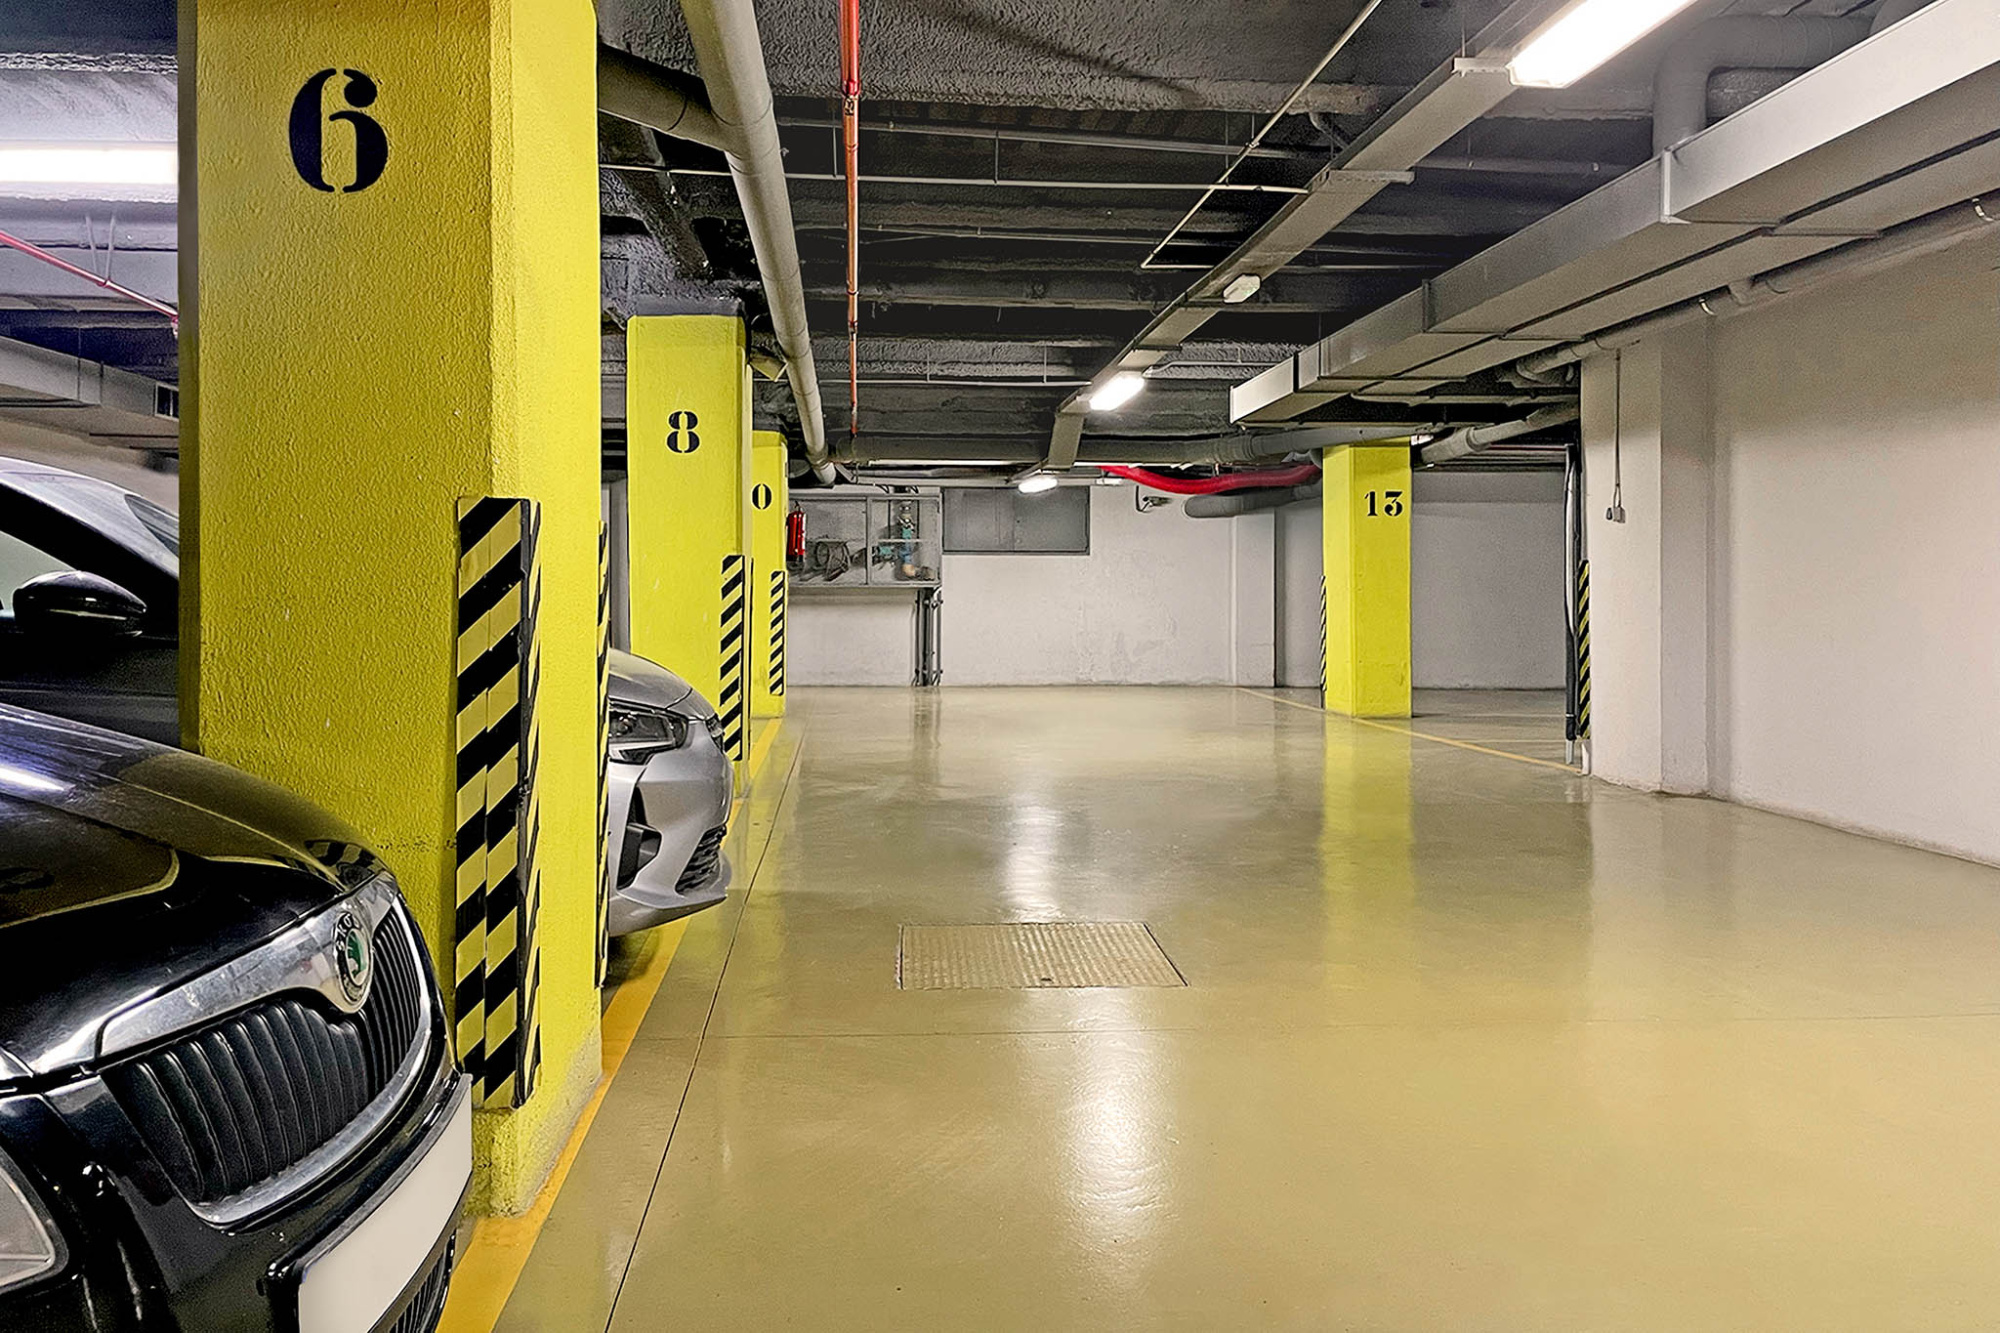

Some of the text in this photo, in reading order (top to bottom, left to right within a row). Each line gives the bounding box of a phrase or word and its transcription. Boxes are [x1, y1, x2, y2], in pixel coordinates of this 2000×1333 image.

[289, 68, 388, 193] 6
[666, 411, 700, 453] 8
[1364, 491, 1403, 516] 13
